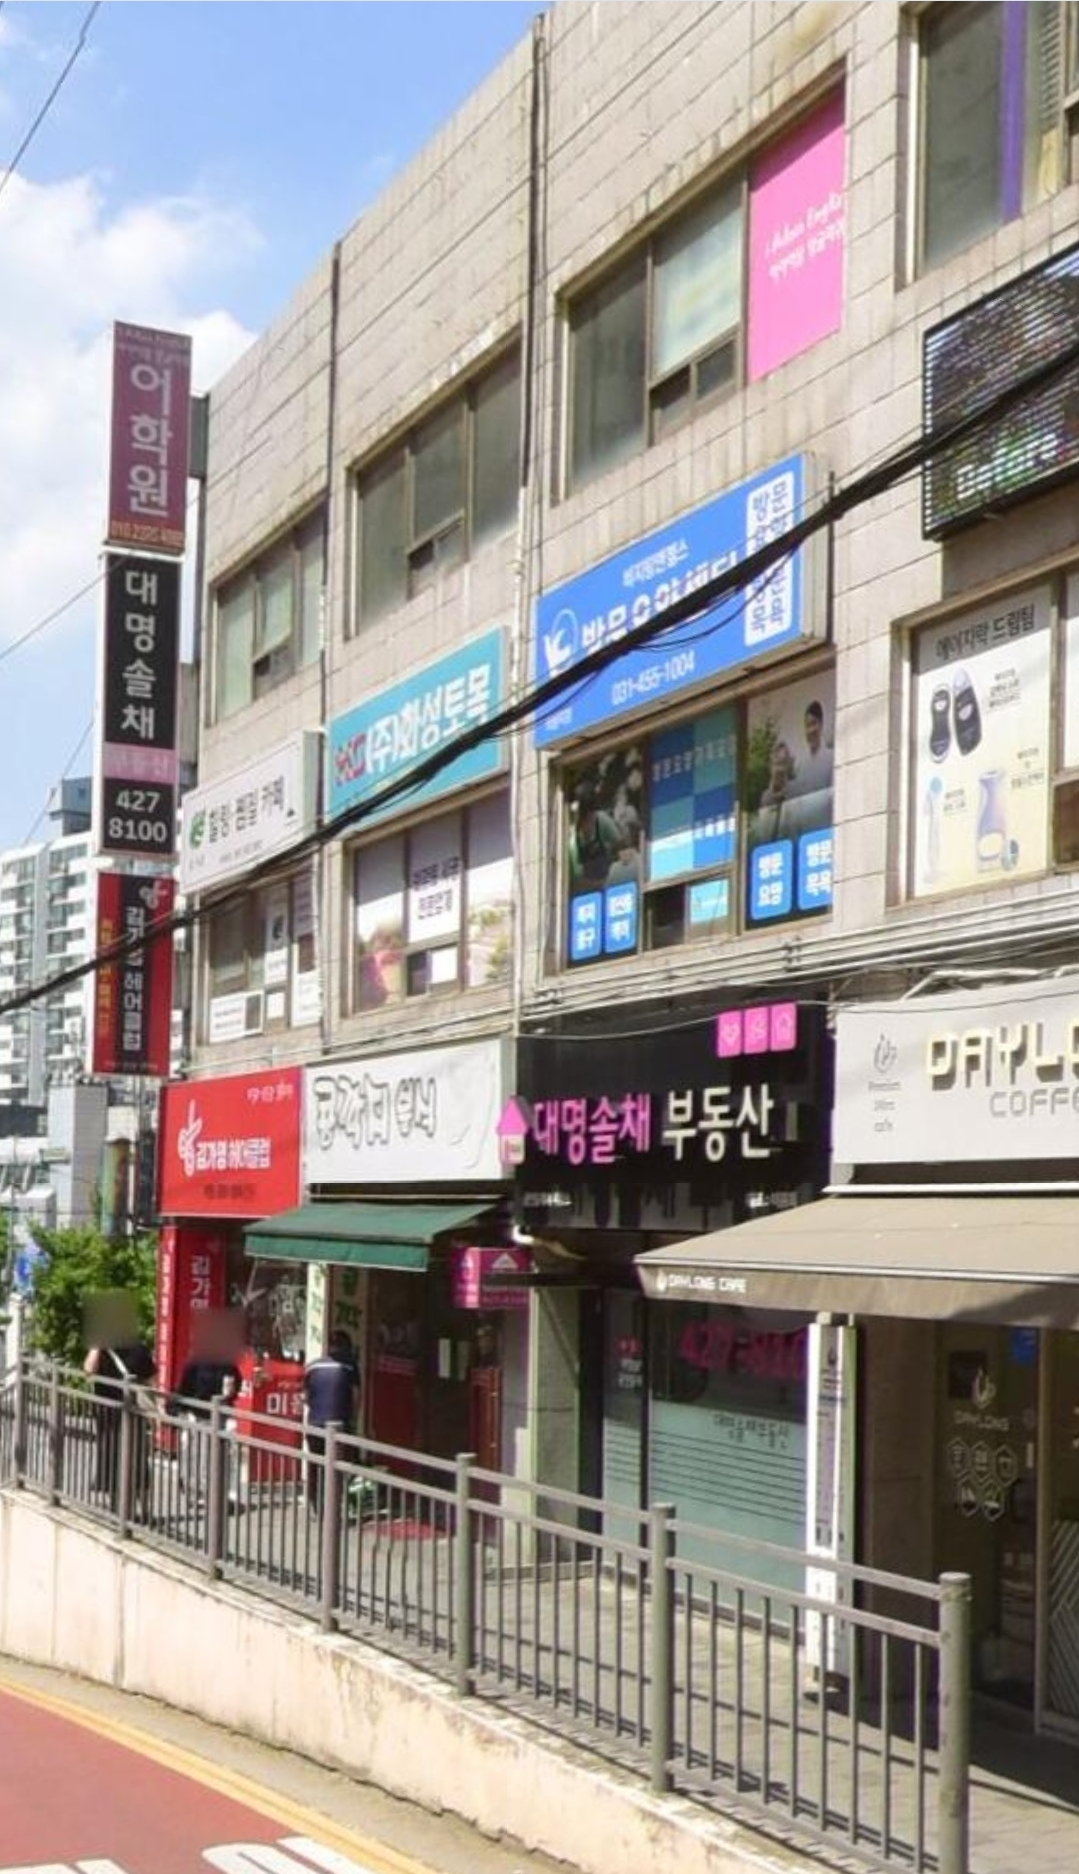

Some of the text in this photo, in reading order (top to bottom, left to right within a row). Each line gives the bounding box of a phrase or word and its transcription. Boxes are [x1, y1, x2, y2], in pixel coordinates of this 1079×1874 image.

[129, 363, 173, 518] 어학원
[992, 604, 1035, 640] 드림팀
[121, 570, 158, 740] 대명솔채
[611, 649, 696, 706] 031-455-1004
[115, 788, 160, 813] 427
[108, 817, 167, 843] 8100
[533, 1084, 774, 1165] 대명솔채 부동산
[667, 1273, 748, 1294] DAYLONG CAFE
